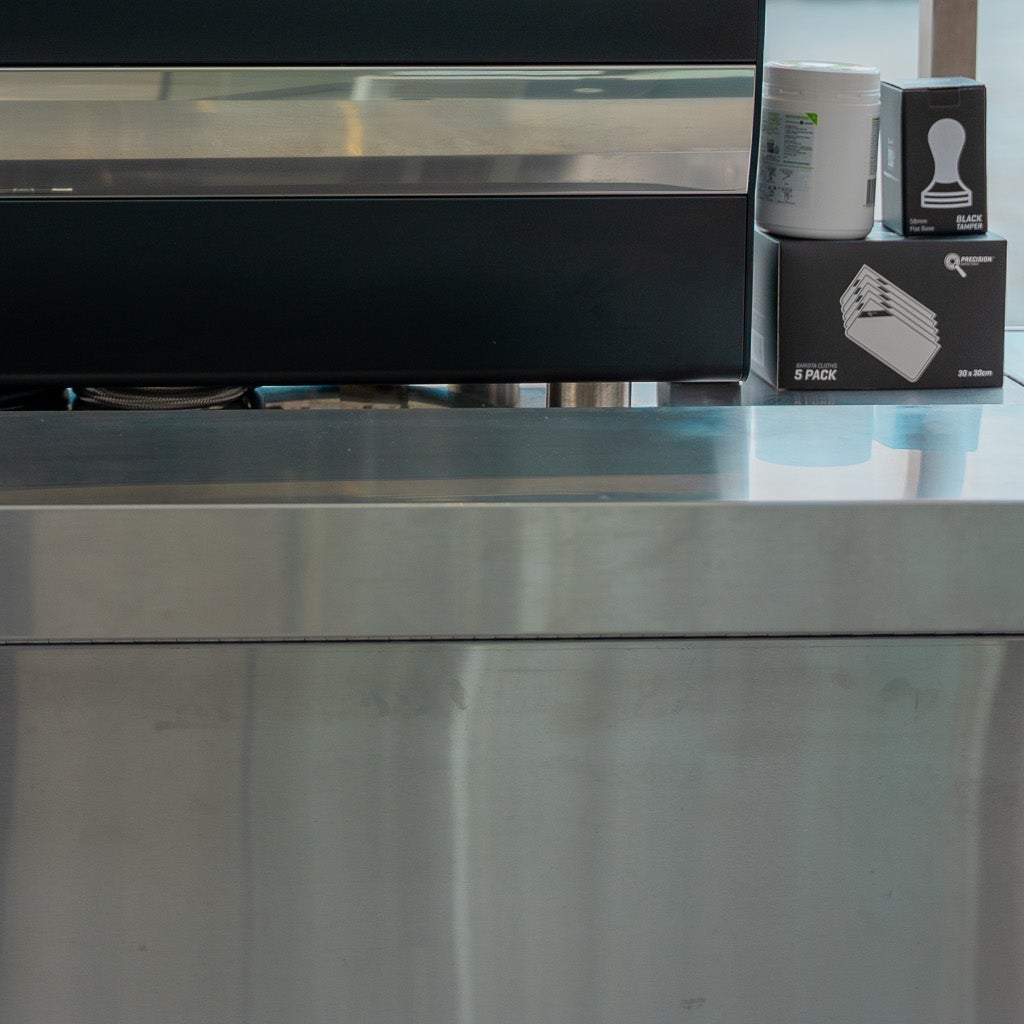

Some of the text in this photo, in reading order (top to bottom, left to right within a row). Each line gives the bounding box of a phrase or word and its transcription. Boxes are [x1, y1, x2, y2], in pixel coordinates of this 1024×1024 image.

[956, 214, 982, 222] BLACK
[960, 255, 993, 263] PRECISION
[794, 369, 837, 381] 5 PACK
[958, 369, 967, 377] 30
[973, 369, 993, 377] 30cm
